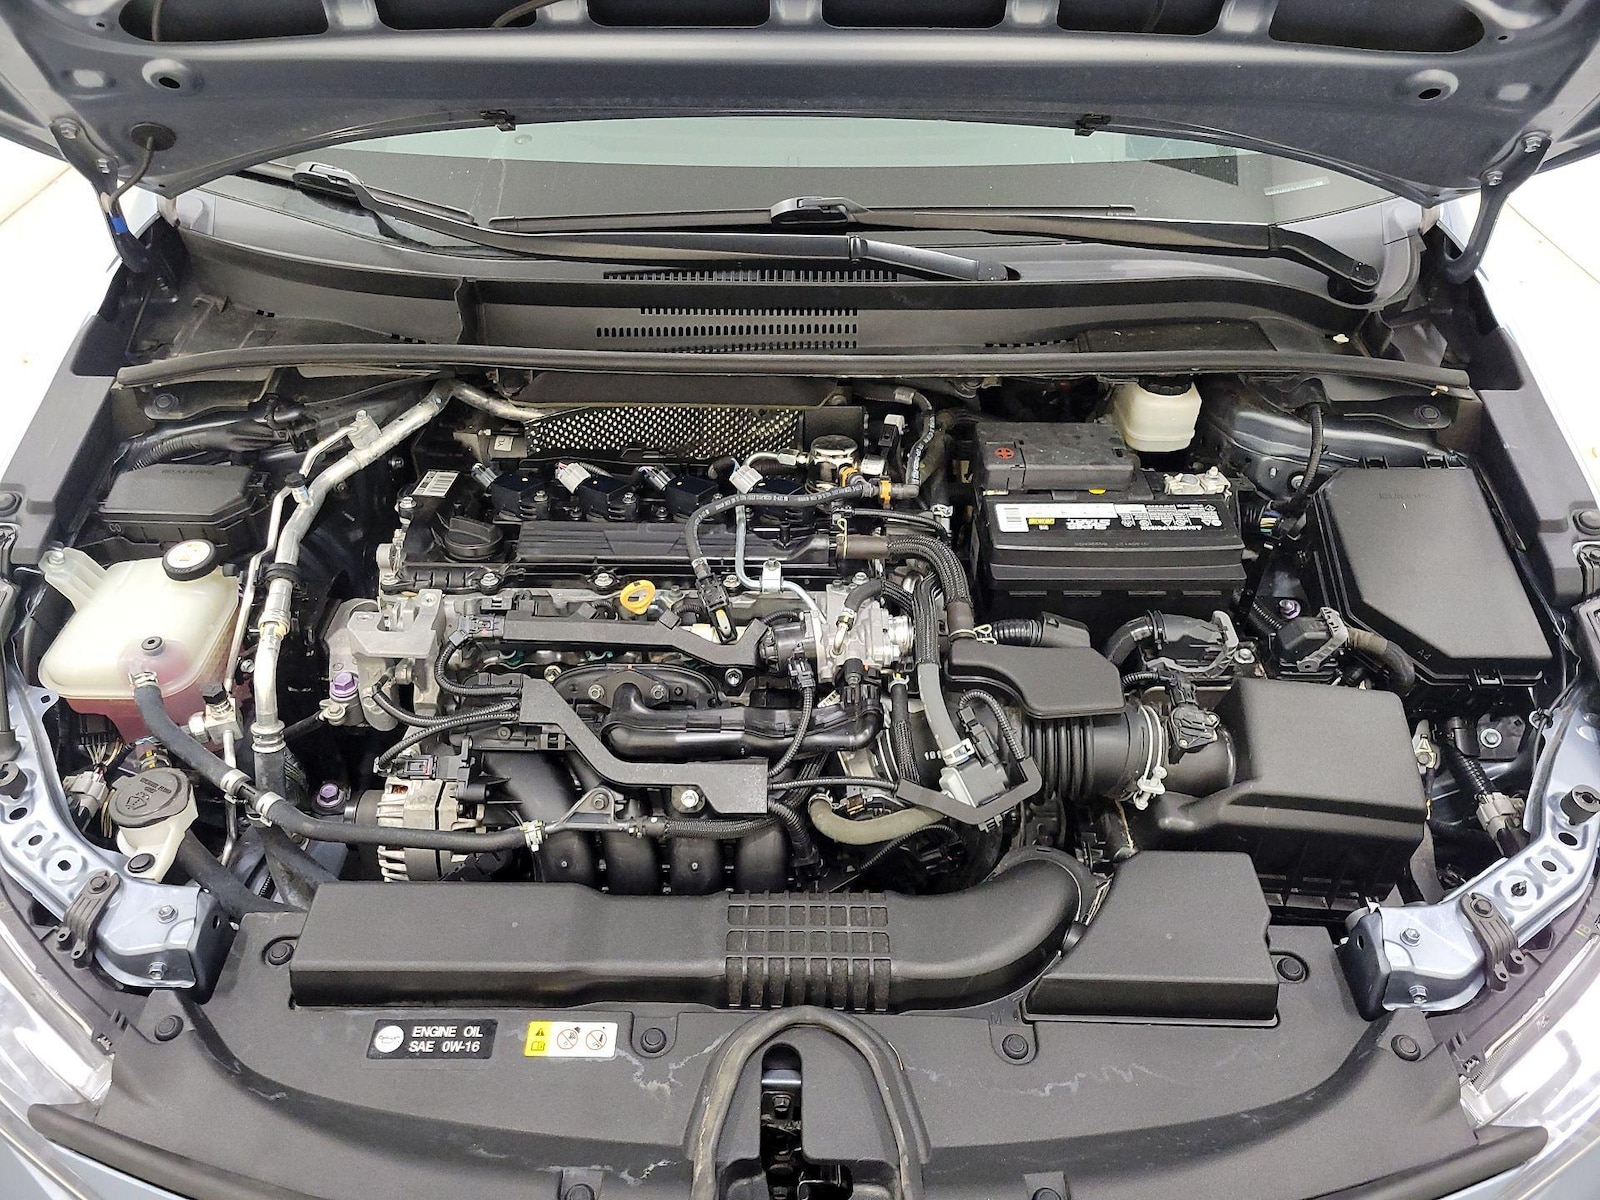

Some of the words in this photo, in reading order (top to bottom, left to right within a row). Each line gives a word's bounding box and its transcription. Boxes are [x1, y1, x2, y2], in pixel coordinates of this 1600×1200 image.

[411, 1025, 457, 1038] ENGINE
[463, 1025, 484, 1038] OIL
[408, 1040, 435, 1053] SAE
[441, 1040, 480, 1053] 0W-16
